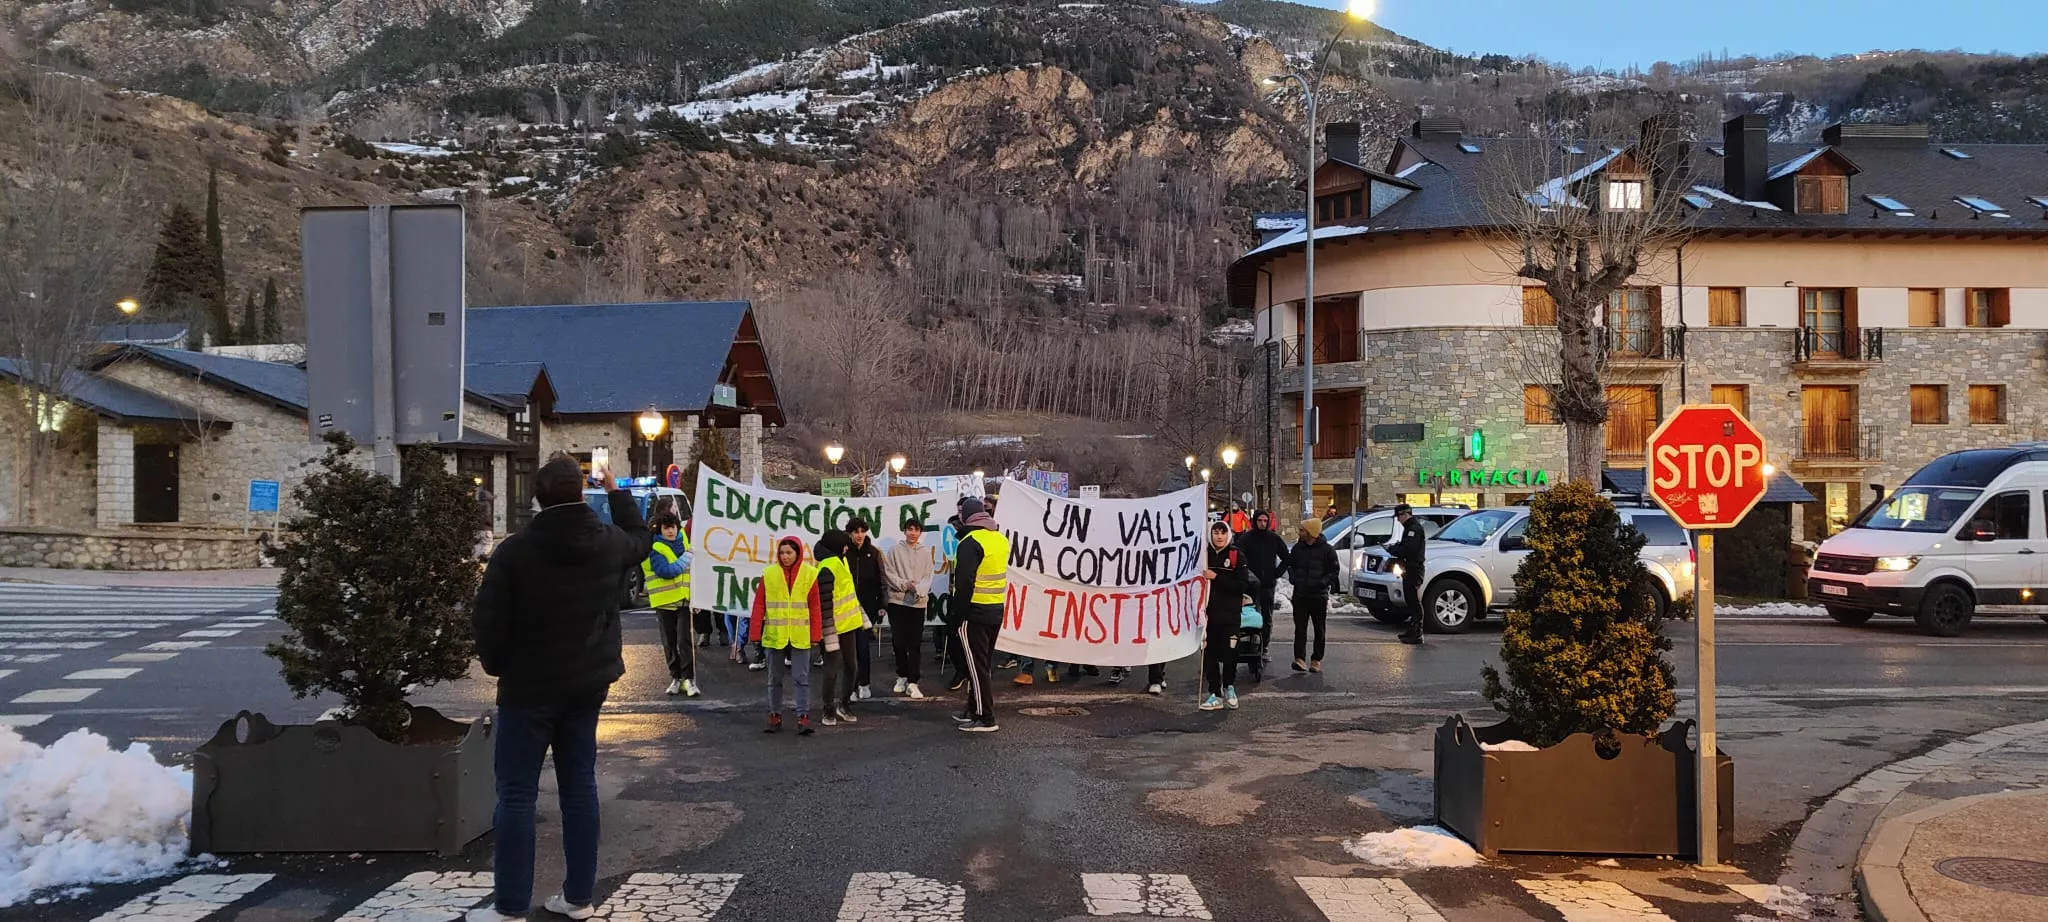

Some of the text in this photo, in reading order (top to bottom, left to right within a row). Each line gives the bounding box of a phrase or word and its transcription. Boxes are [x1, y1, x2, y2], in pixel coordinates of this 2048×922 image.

[1655, 444, 1760, 489] STOP
[900, 499, 940, 532] DE
[1043, 498, 1195, 547] UN VALLE
[1039, 575, 1207, 645] INSTITUTO
